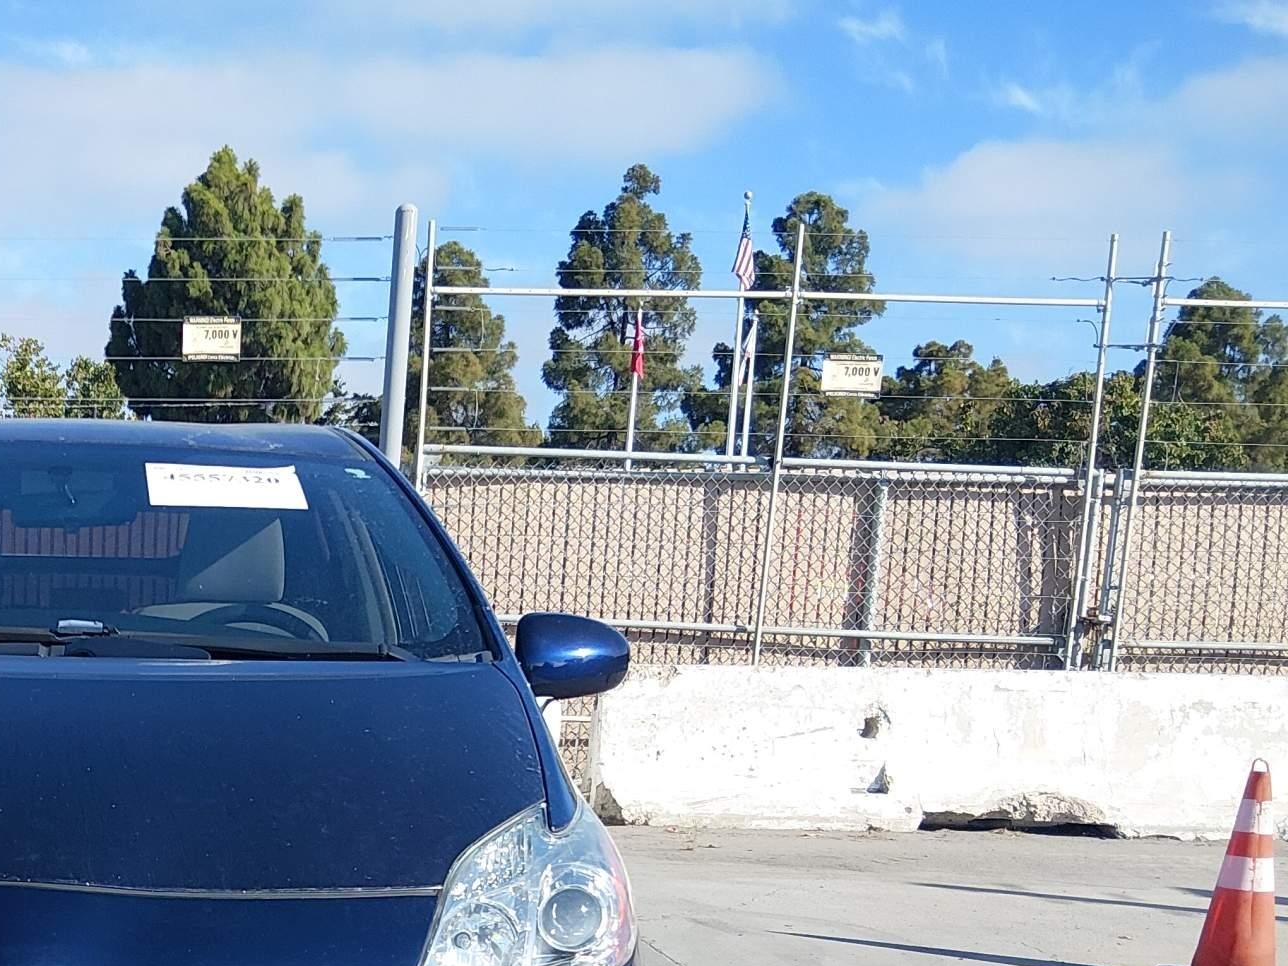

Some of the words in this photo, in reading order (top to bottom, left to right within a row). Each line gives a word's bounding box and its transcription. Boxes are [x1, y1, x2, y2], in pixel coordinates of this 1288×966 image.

[204, 329, 230, 341] 7,000
[232, 329, 238, 339] V
[844, 366, 871, 377] 7,000
[873, 367, 880, 377] V
